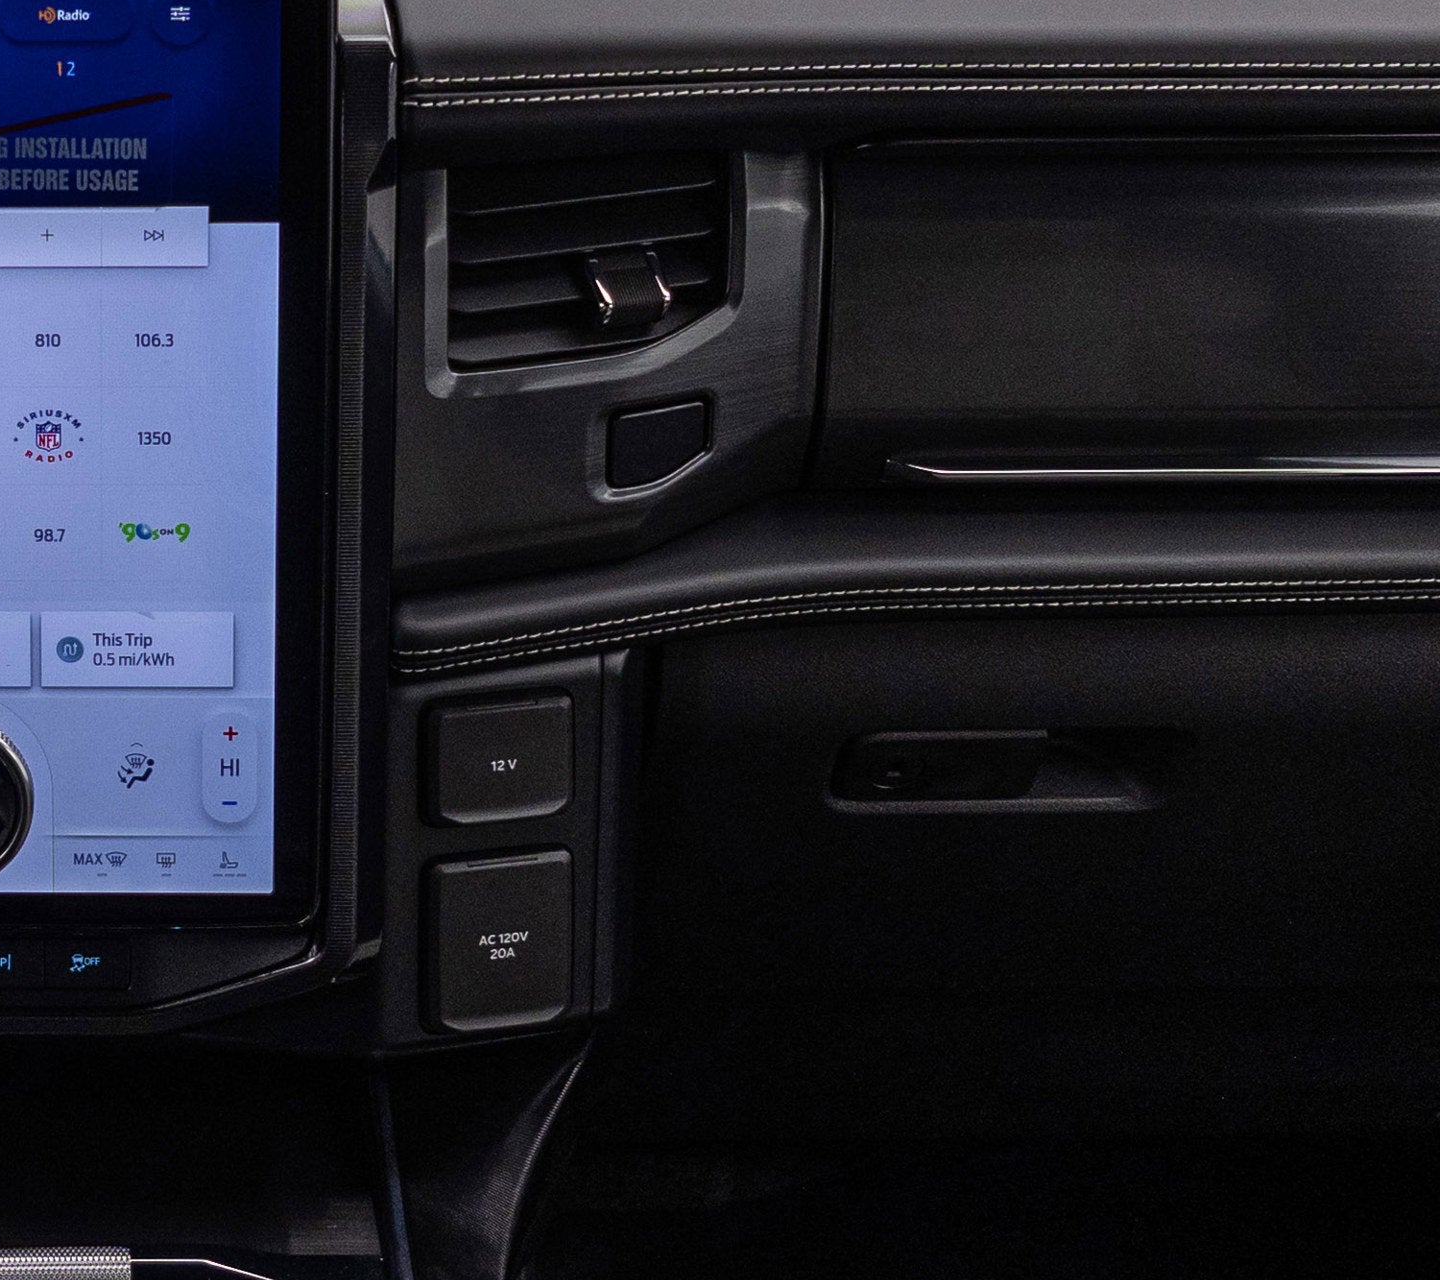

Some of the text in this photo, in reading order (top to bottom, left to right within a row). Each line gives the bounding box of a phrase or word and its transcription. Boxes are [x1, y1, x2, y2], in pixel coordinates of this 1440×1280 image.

[66, 61, 75, 76] 2
[15, 137, 147, 160] INSTALLATION
[76, 169, 139, 191] USAGE
[35, 334, 61, 347] 810
[135, 334, 174, 347] 106.3
[17, 409, 82, 430] SIRIUSXM
[38, 433, 60, 448] NFL
[137, 432, 171, 445] 1350
[25, 450, 73, 463] RADIO
[34, 529, 65, 542] 98.7
[175, 523, 190, 542] 9
[93, 633, 153, 650] This Trip
[93, 653, 175, 667] 0.5 mi/kWh
[221, 758, 240, 777] HI
[491, 759, 518, 772] 12 V
[73, 853, 103, 865] MAX
[478, 931, 529, 946] AC 120V
[489, 947, 516, 960] 20A
[84, 956, 101, 966] OFF
